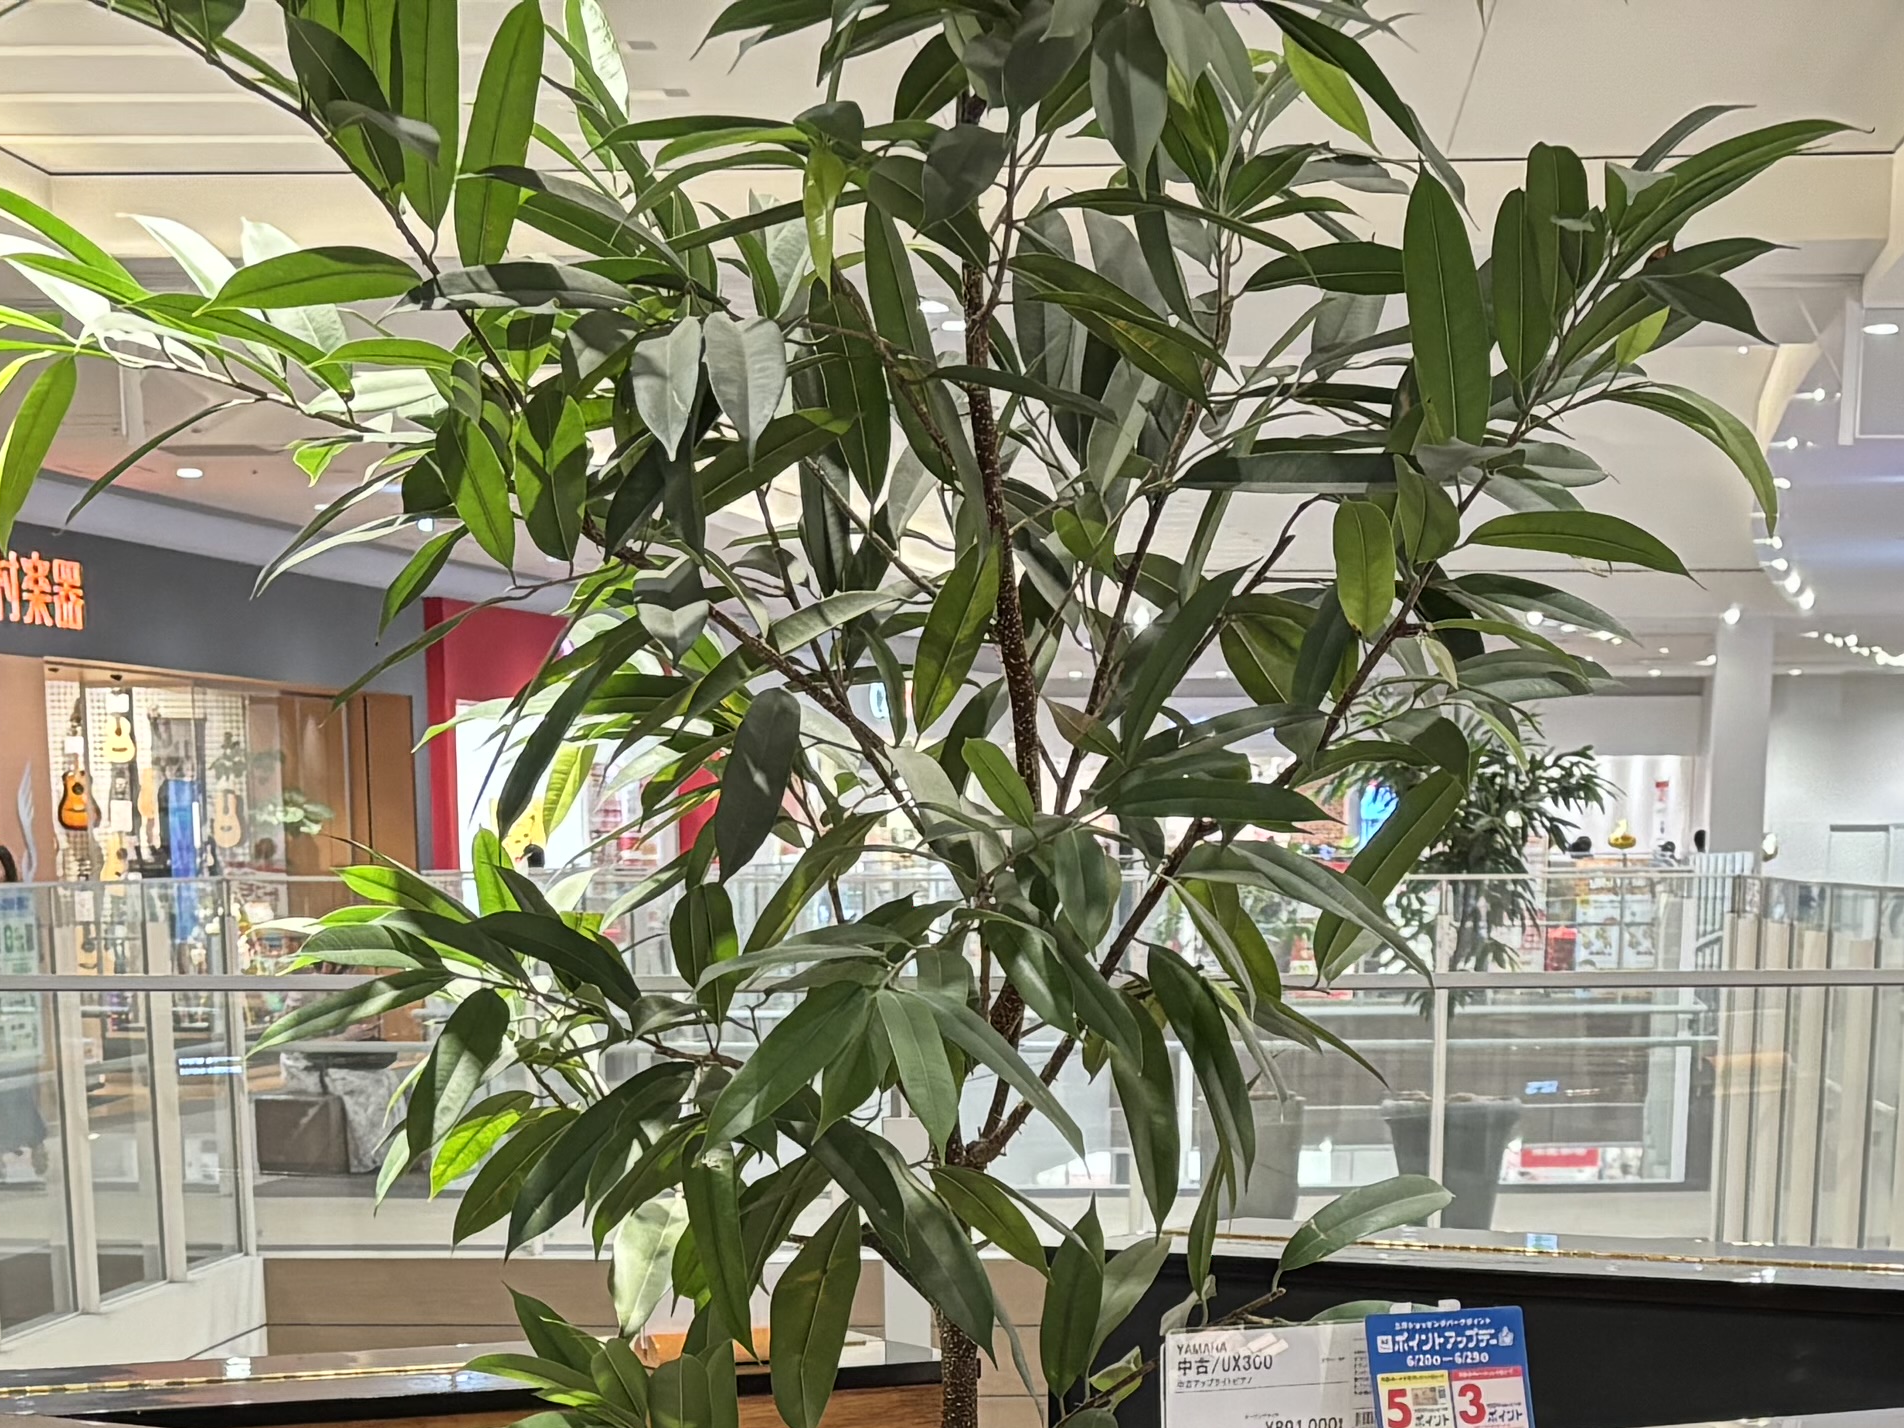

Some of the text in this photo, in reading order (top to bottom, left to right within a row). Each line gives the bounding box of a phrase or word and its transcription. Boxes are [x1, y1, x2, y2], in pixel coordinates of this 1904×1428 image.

[1177, 1341, 1228, 1355] YAMAHA
[1394, 1328, 1498, 1353] ポイントアップデー
[1177, 1354, 1274, 1376] 中古/UX300
[1458, 1383, 1487, 1425] 3
[1415, 1413, 1449, 1428] ポイント
[1487, 1409, 1523, 1423] ポイント
